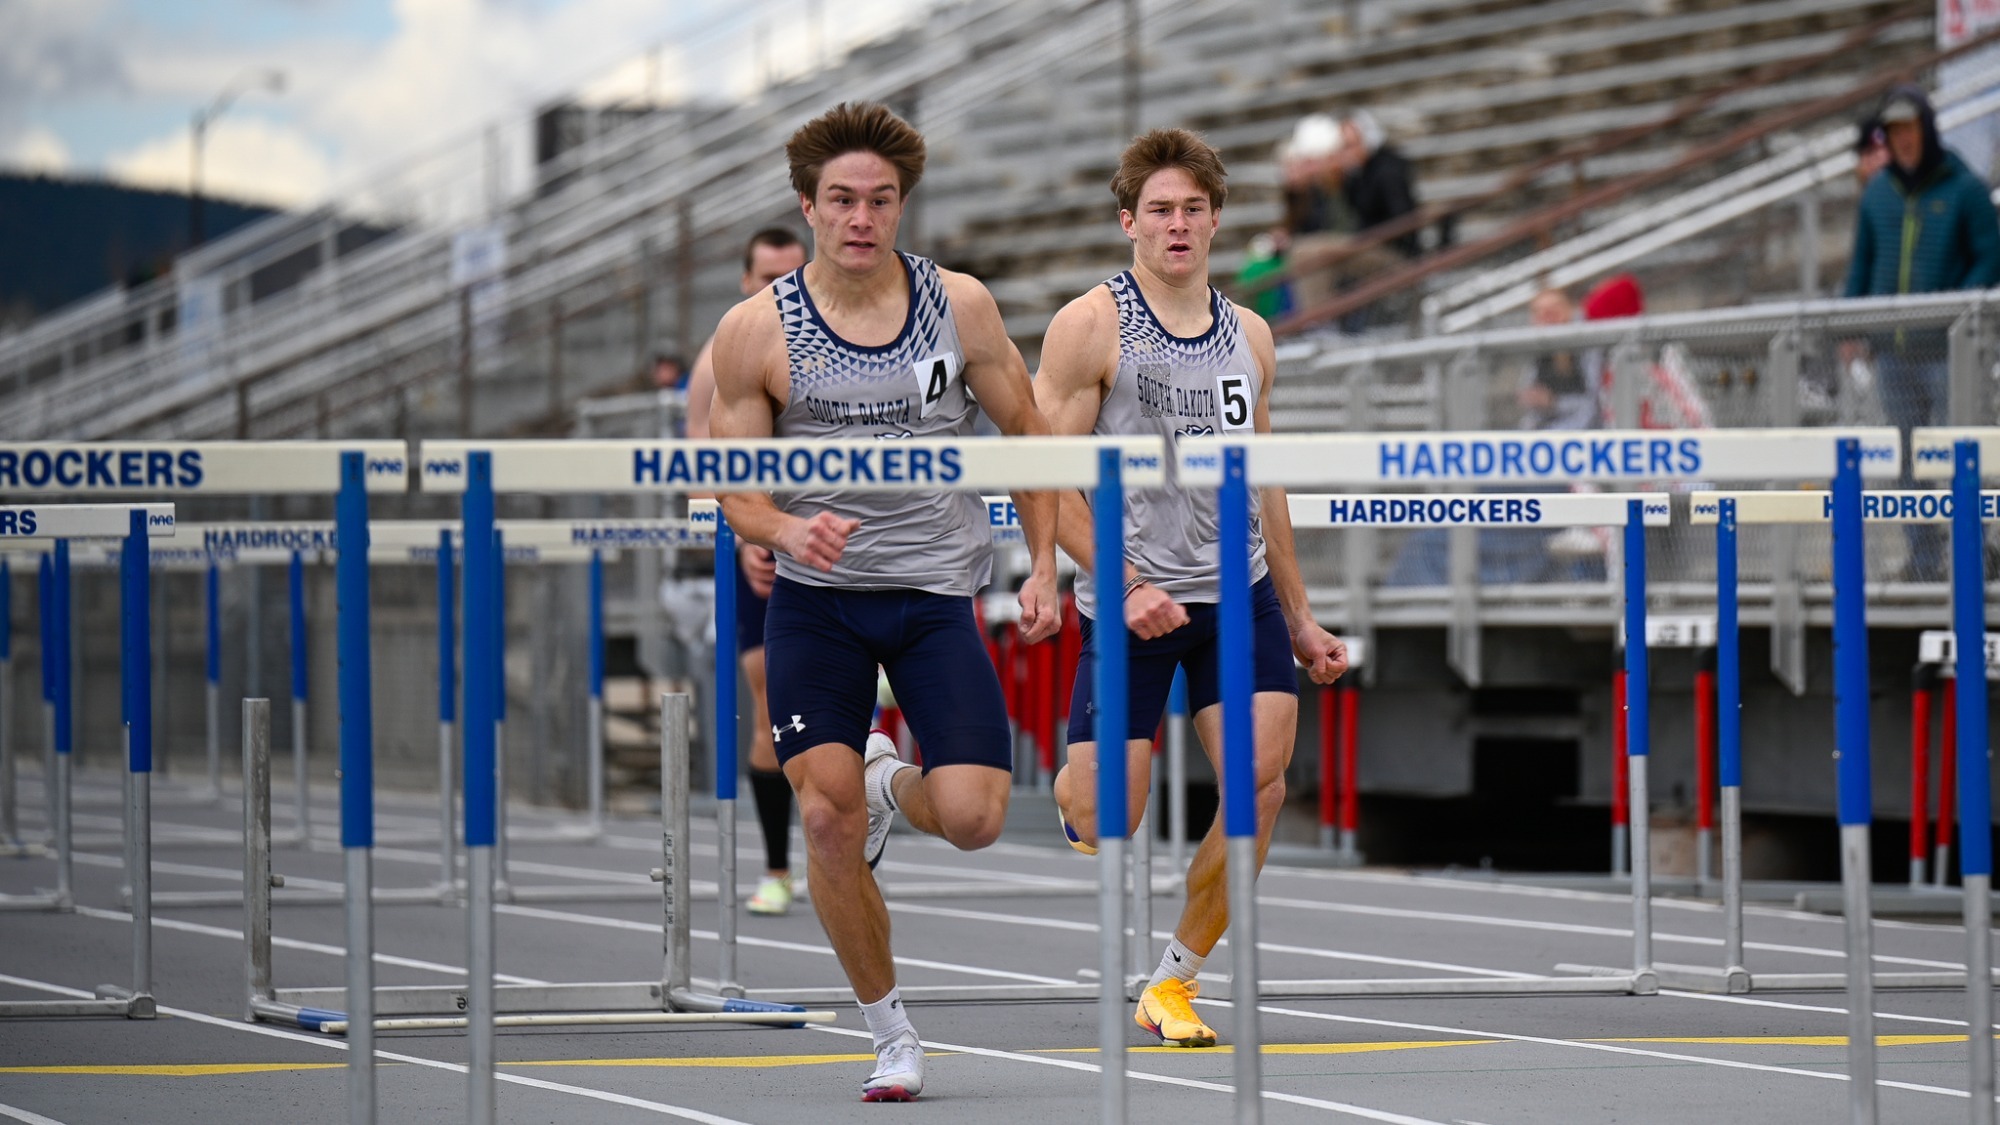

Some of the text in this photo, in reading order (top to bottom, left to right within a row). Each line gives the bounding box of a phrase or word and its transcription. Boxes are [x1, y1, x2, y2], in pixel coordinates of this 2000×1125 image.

[926, 359, 948, 405] 4
[1137, 373, 1173, 413] SOUTH
[1176, 388, 1215, 417] DAKOTA
[806, 396, 910, 426] SOUTH DAKOTA
[1222, 379, 1247, 425] 5
[0, 450, 203, 487] ROCKERS
[634, 448, 962, 483] HARDROCKERS
[1379, 439, 1702, 477] HARDROCKERS
[1330, 498, 1542, 523] HARDROCKERS
